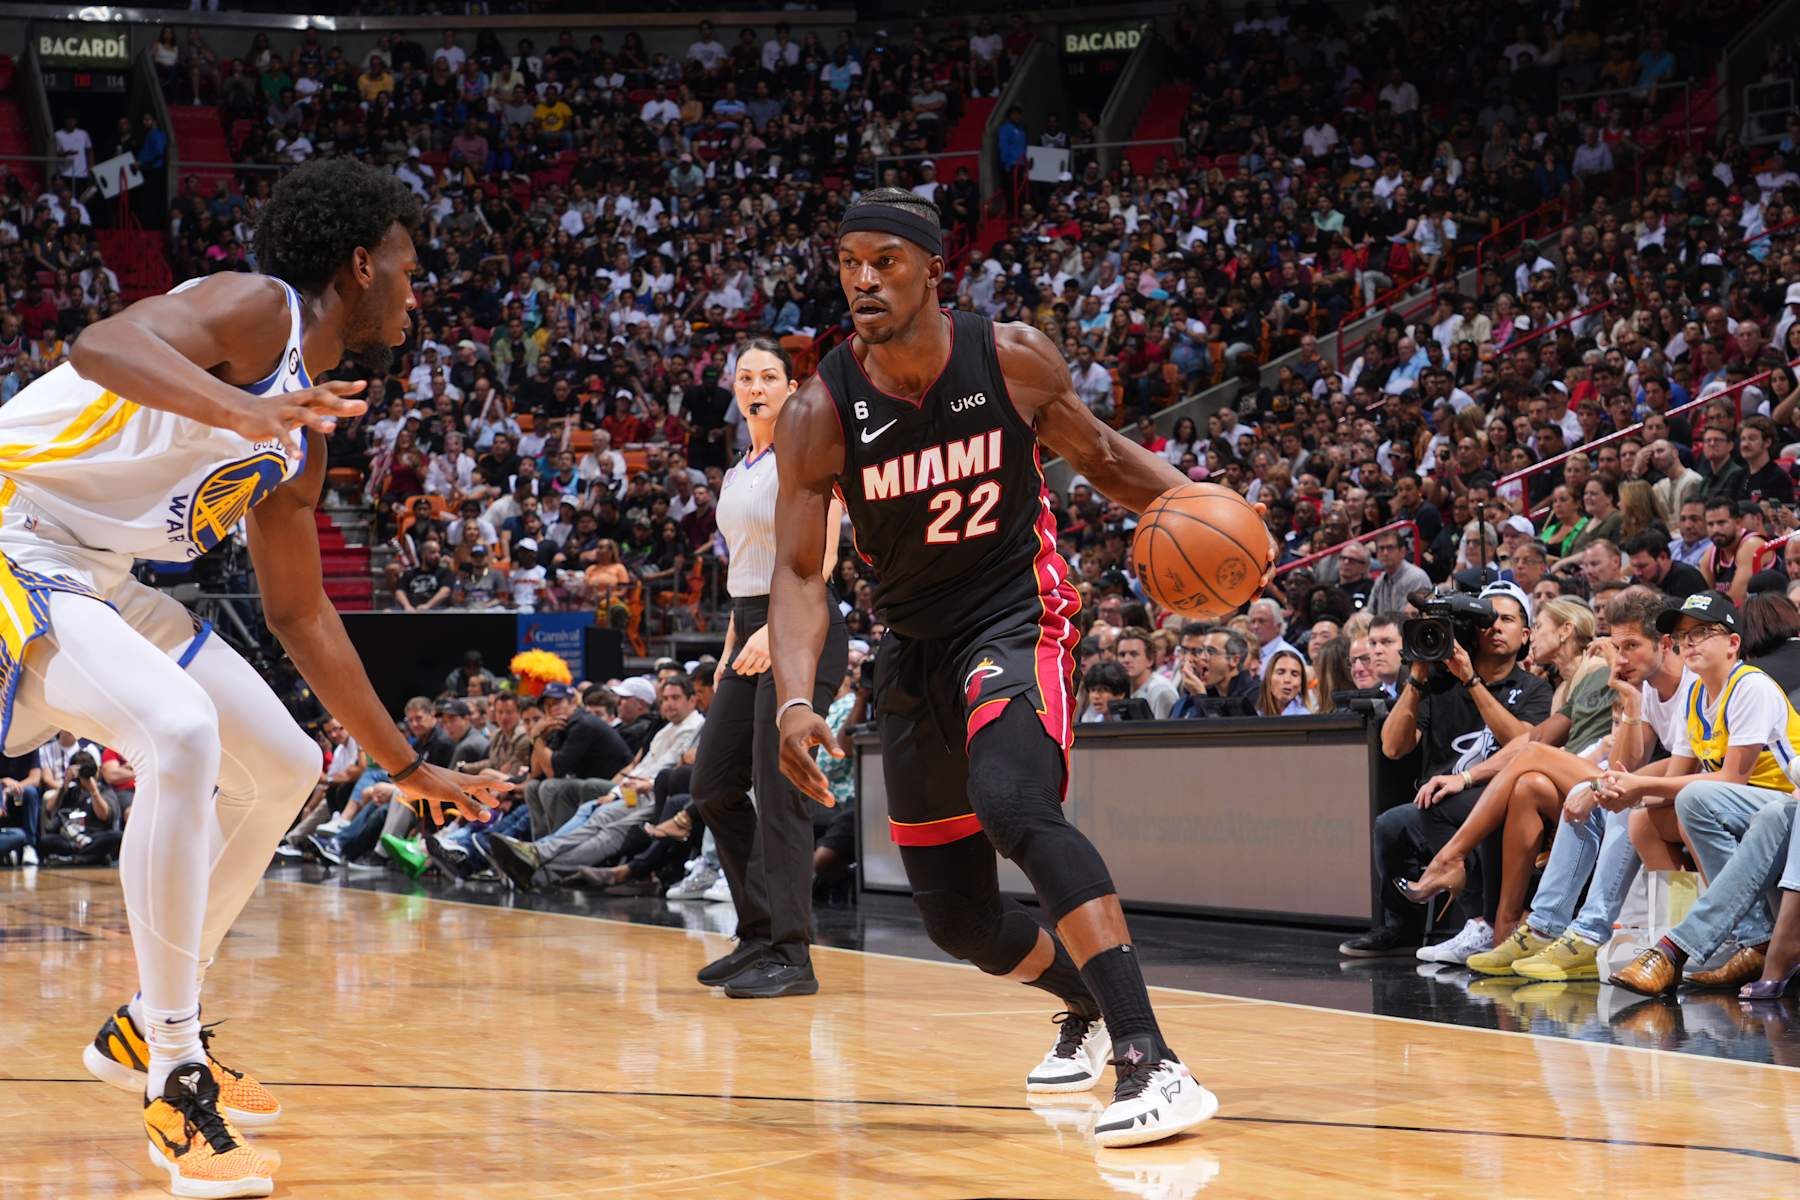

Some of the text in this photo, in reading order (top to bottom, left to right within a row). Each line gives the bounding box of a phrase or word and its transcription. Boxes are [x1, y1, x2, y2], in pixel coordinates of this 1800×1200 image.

[40, 34, 128, 58] BACARDÍ
[1065, 24, 1148, 52] BACARD
[290, 350, 299, 372] 6
[854, 400, 870, 420] 6
[862, 427, 1003, 501] MIAMI
[925, 479, 1002, 544] 22
